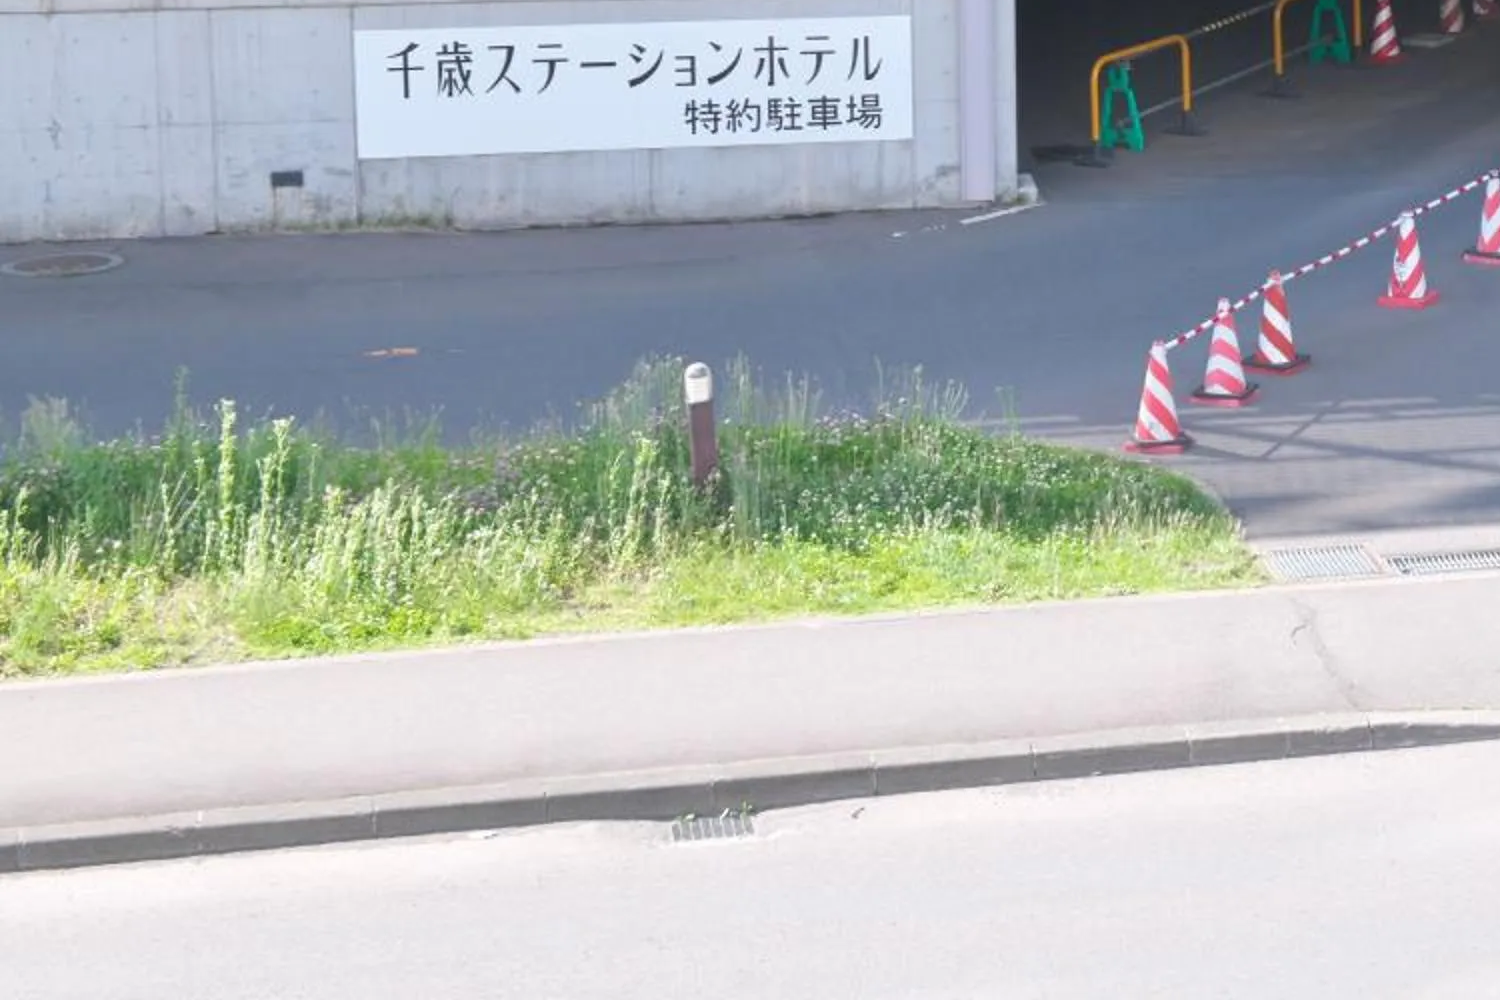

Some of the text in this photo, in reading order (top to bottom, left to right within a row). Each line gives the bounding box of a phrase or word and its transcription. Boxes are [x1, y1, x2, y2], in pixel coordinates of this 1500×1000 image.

[386, 35, 884, 99] 千歳ステーションホテル
[684, 94, 884, 135] 特約駐車場
